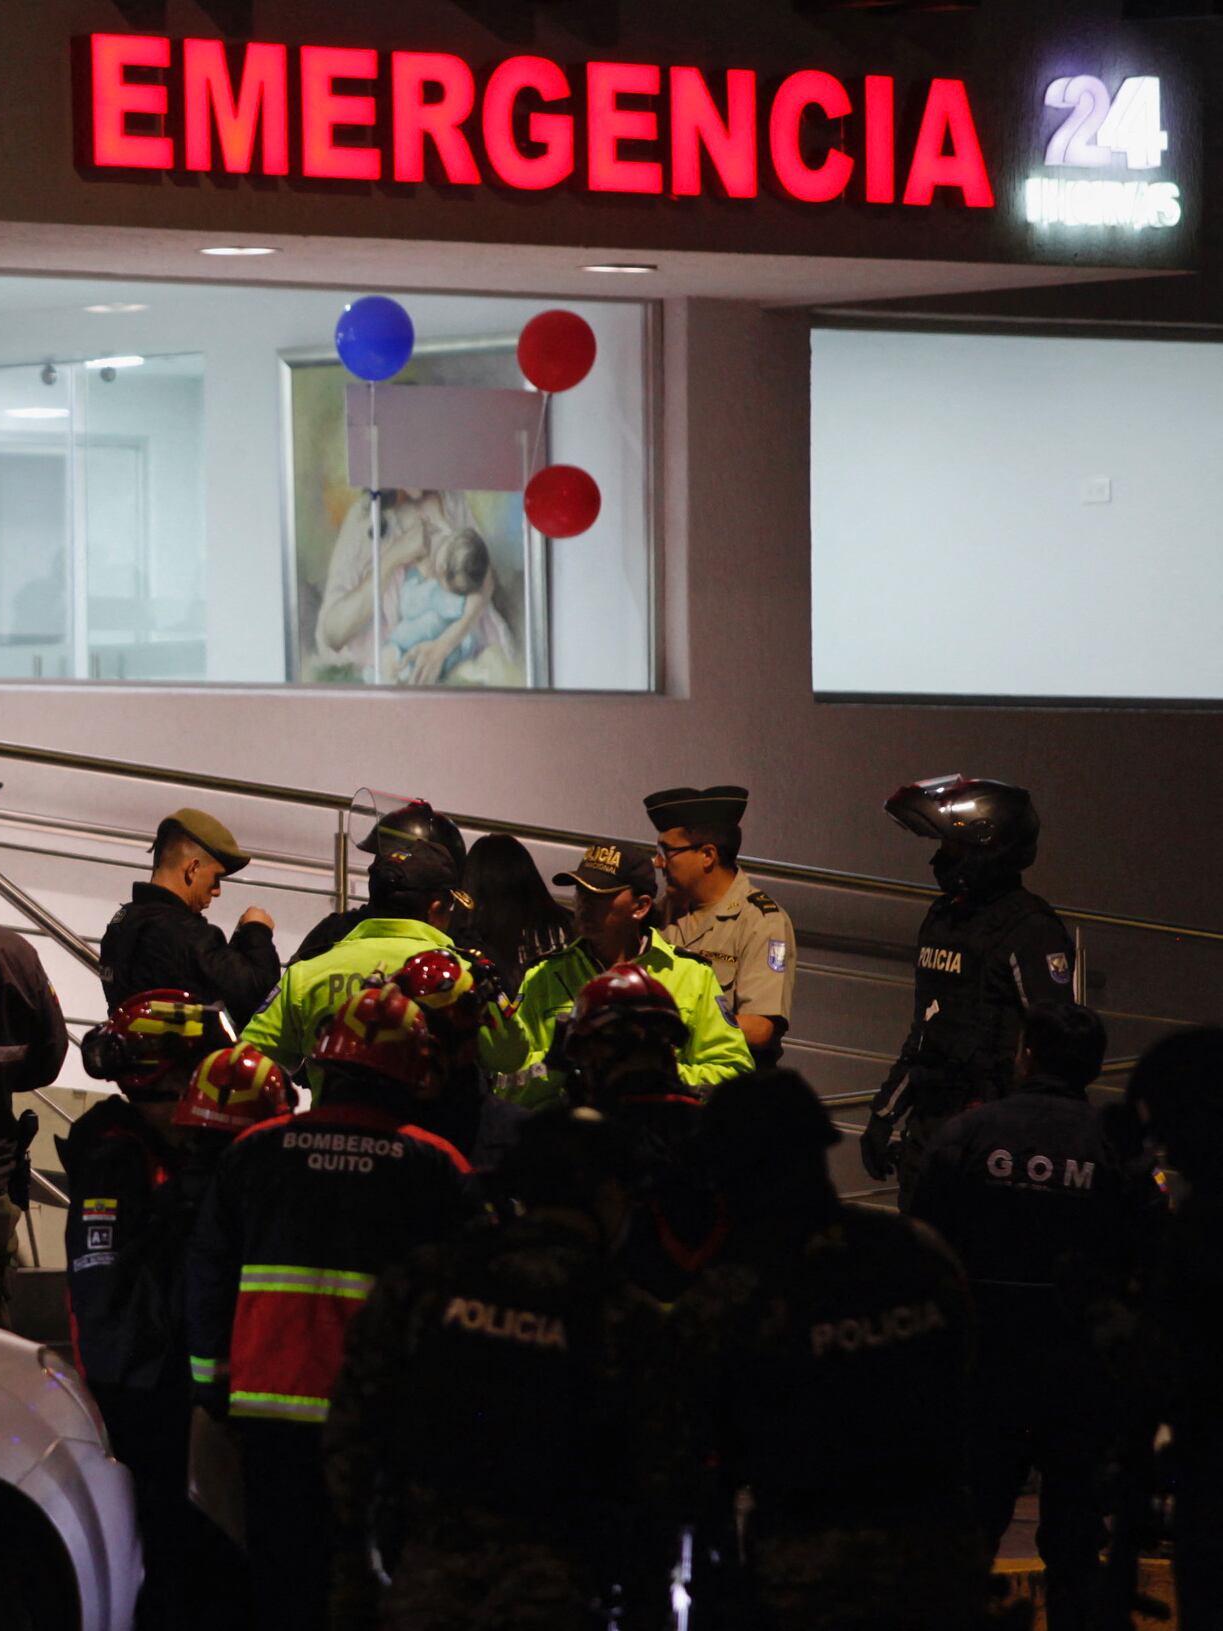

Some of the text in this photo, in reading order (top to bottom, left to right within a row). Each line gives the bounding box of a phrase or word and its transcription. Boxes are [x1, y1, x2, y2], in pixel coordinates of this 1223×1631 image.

[89, 32, 995, 208] EMERGENCIA
[1044, 75, 1168, 169] 24
[282, 1131, 404, 1159] BOMBEROS
[307, 1152, 374, 1173] QUITO
[442, 1297, 568, 1350] POLICIA
[811, 1300, 948, 1357] POLICIA
